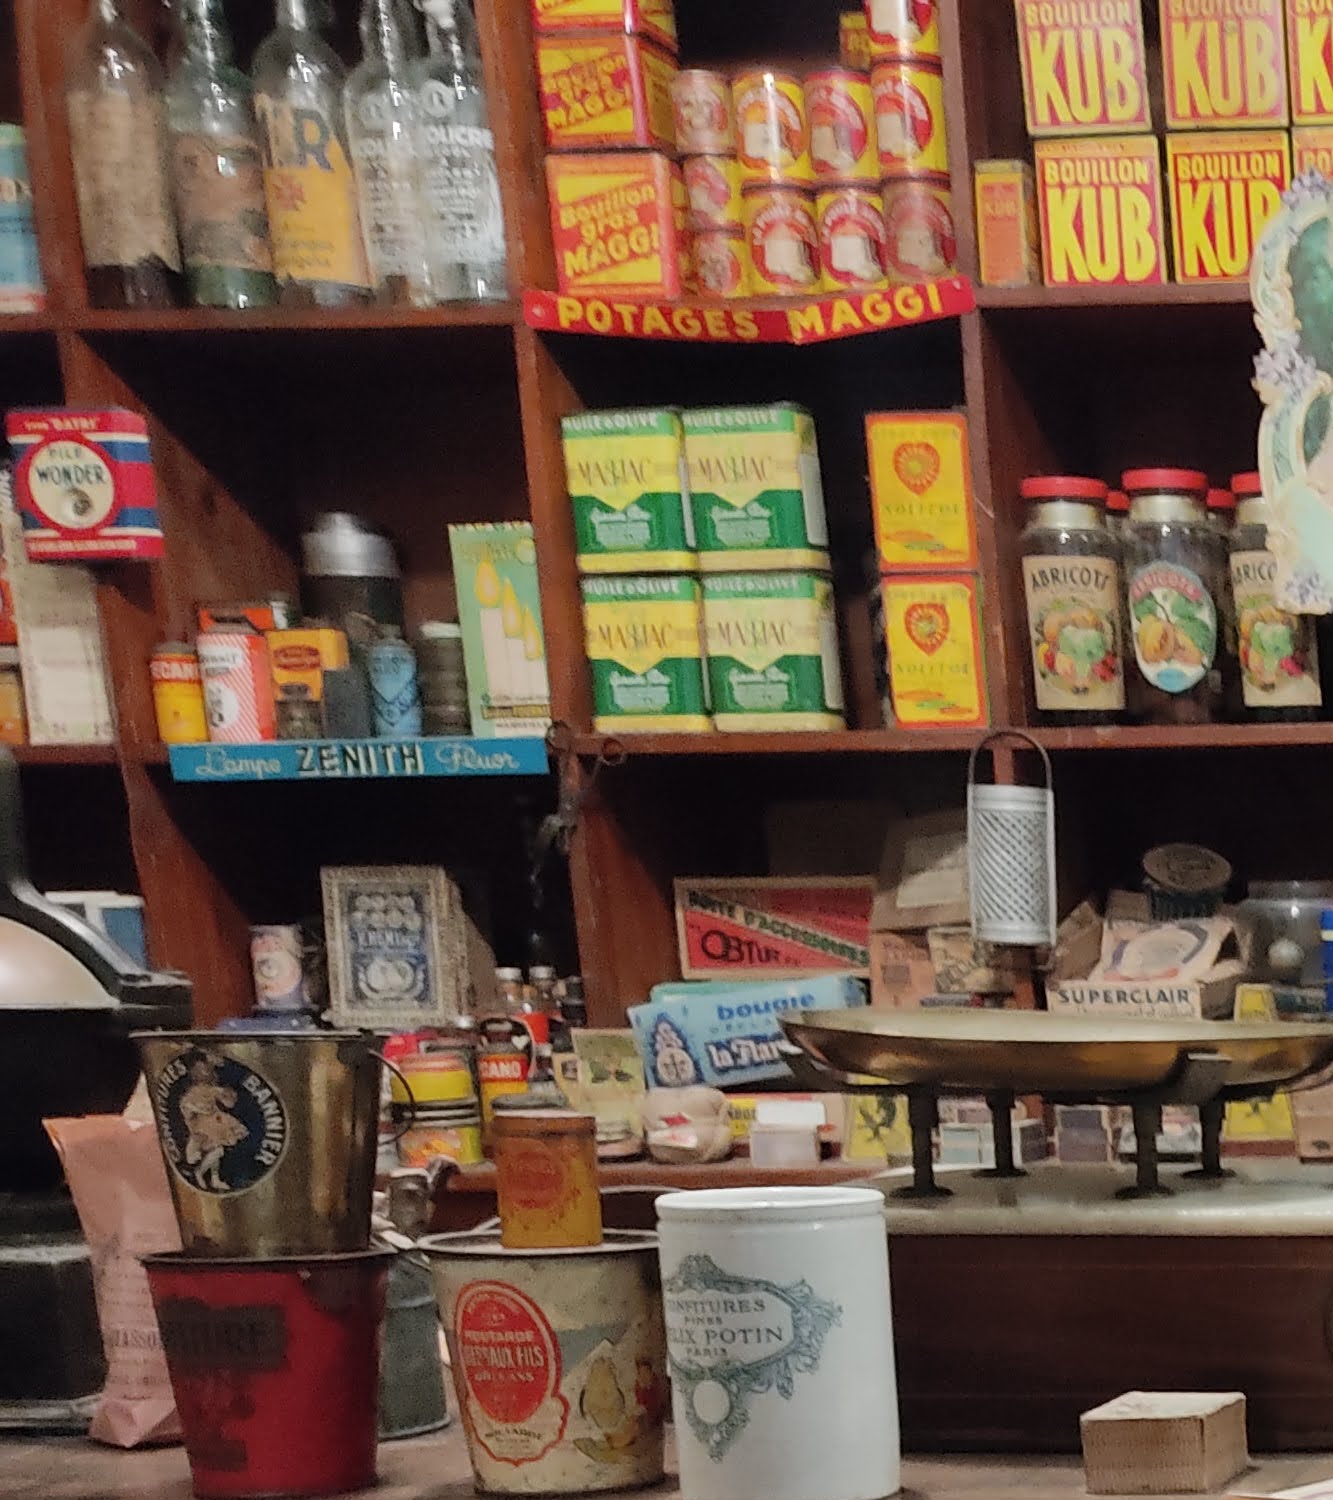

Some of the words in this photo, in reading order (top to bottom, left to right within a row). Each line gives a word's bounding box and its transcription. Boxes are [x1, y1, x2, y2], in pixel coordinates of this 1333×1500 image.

[1029, 27, 1140, 124] KUB
[1171, 19, 1279, 117] KUB
[1045, 159, 1149, 186] BOUILLON
[1178, 151, 1279, 181] BOUILLON
[564, 226, 662, 278] MAGGI
[1047, 186, 1157, 284] KUB
[556, 297, 760, 340] POTAGES
[786, 283, 944, 339] MAGGI
[36, 465, 105, 486] WONDER
[195, 746, 283, 777] Lampe
[296, 742, 425, 777] ZENITH
[1058, 987, 1191, 1005] SUPERCLAIR
[242, 1074, 284, 1166] BANNIER
[705, 1326, 783, 1345] POTIN
[517, 1346, 545, 1368] FILS
